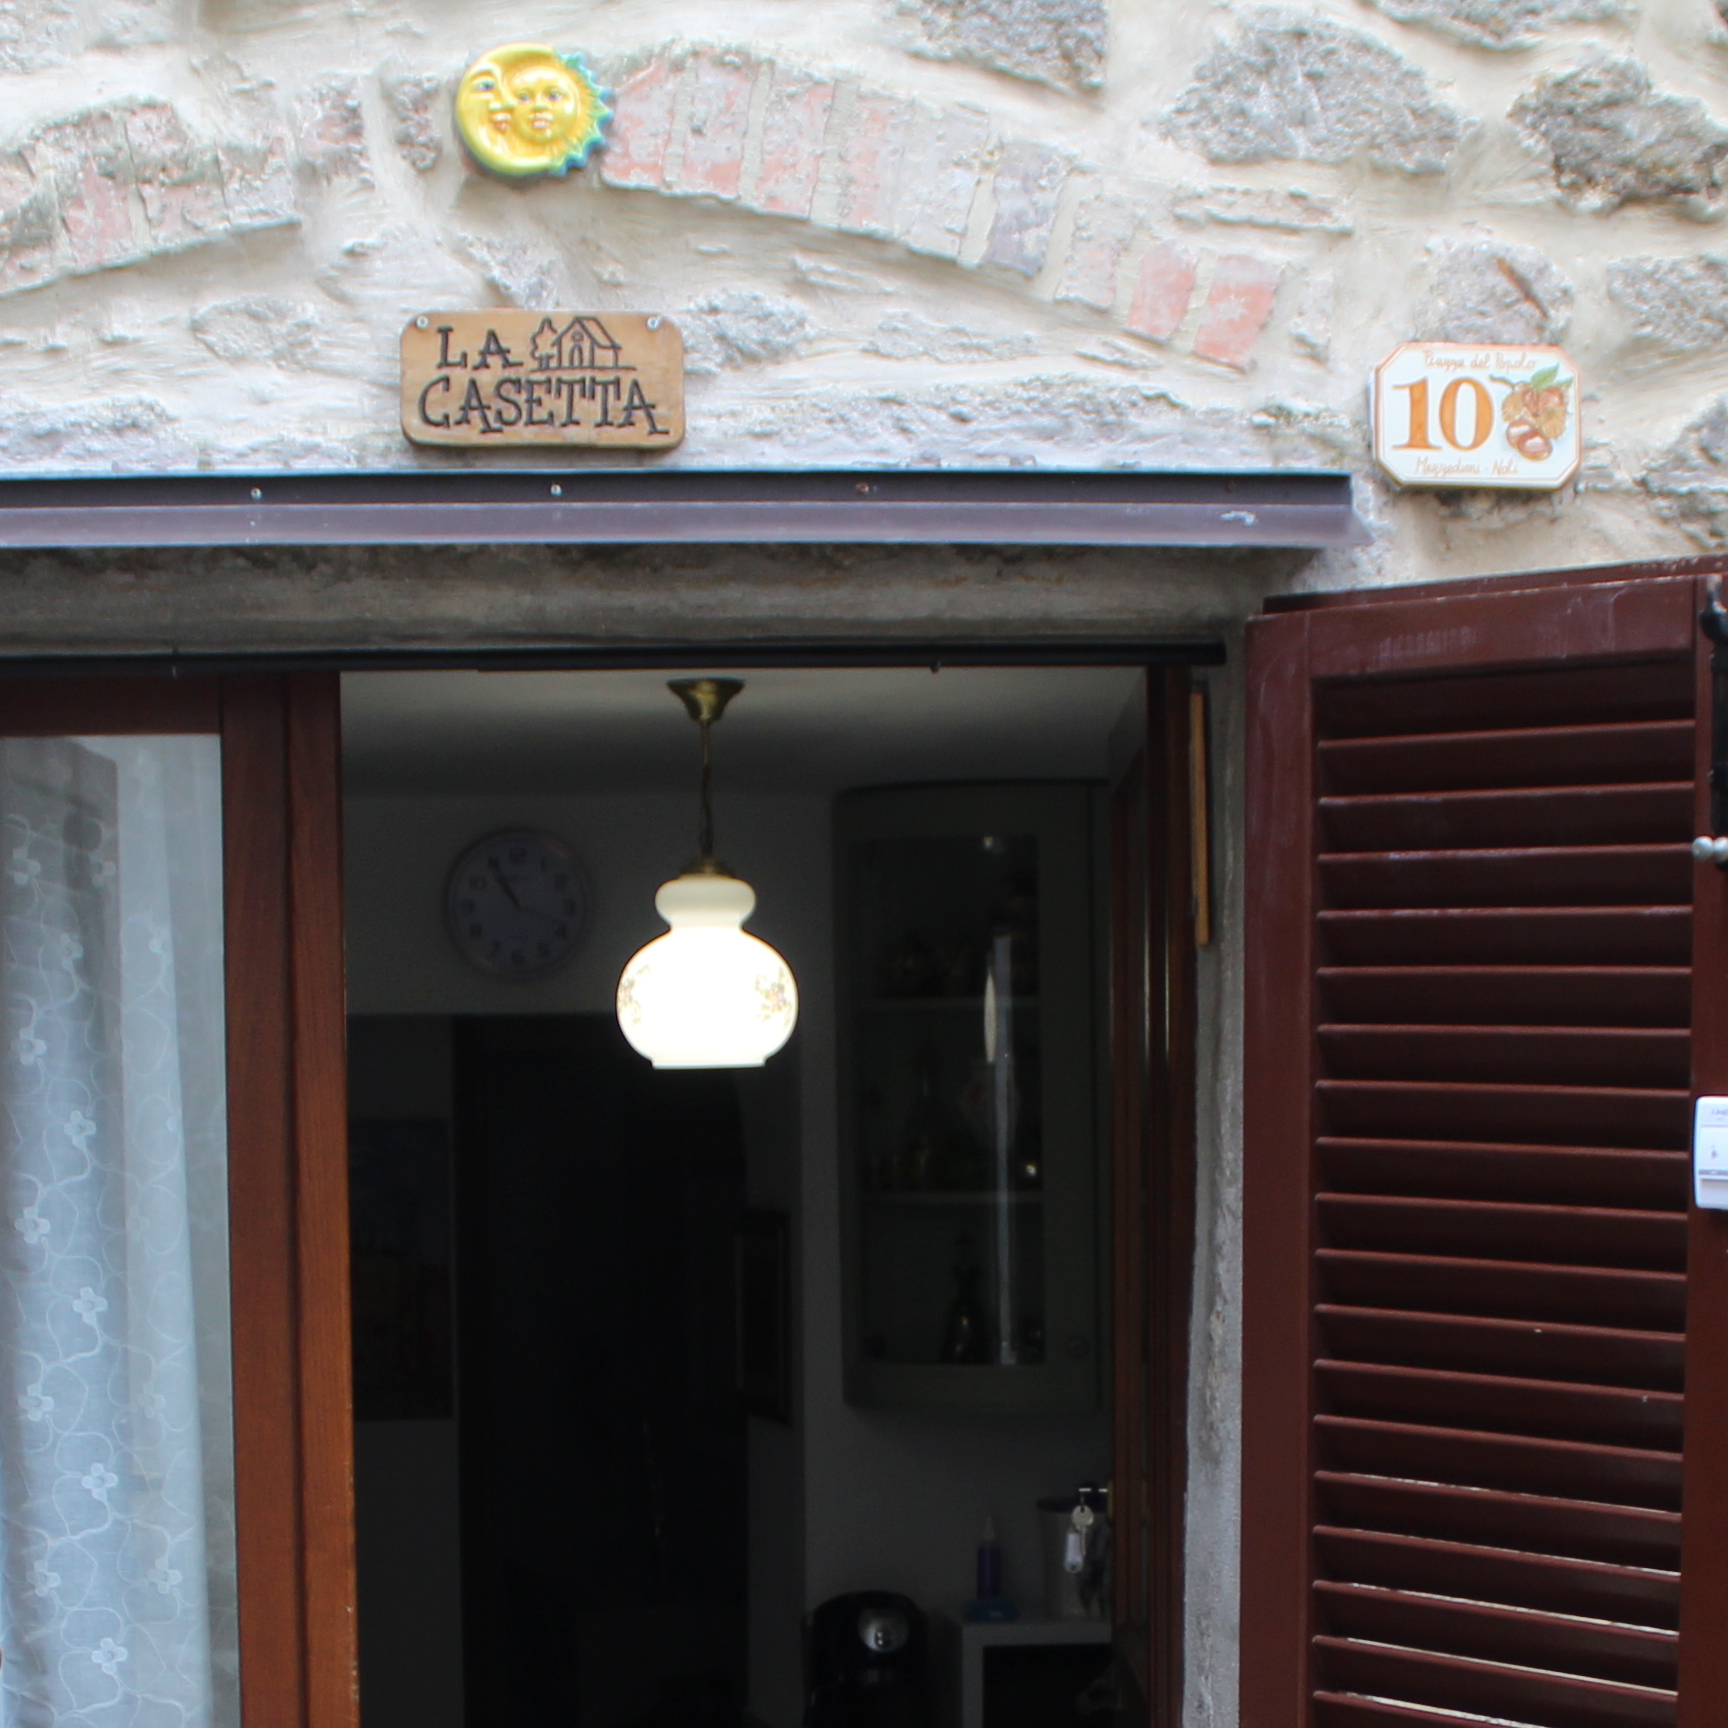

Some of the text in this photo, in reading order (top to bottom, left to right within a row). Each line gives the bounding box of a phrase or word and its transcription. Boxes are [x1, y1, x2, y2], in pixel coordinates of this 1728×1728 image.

[437, 325, 524, 370] LA
[1422, 350, 1537, 374] Piazza del Popolo
[418, 375, 670, 434] CASETTA
[1391, 376, 1495, 452] 10
